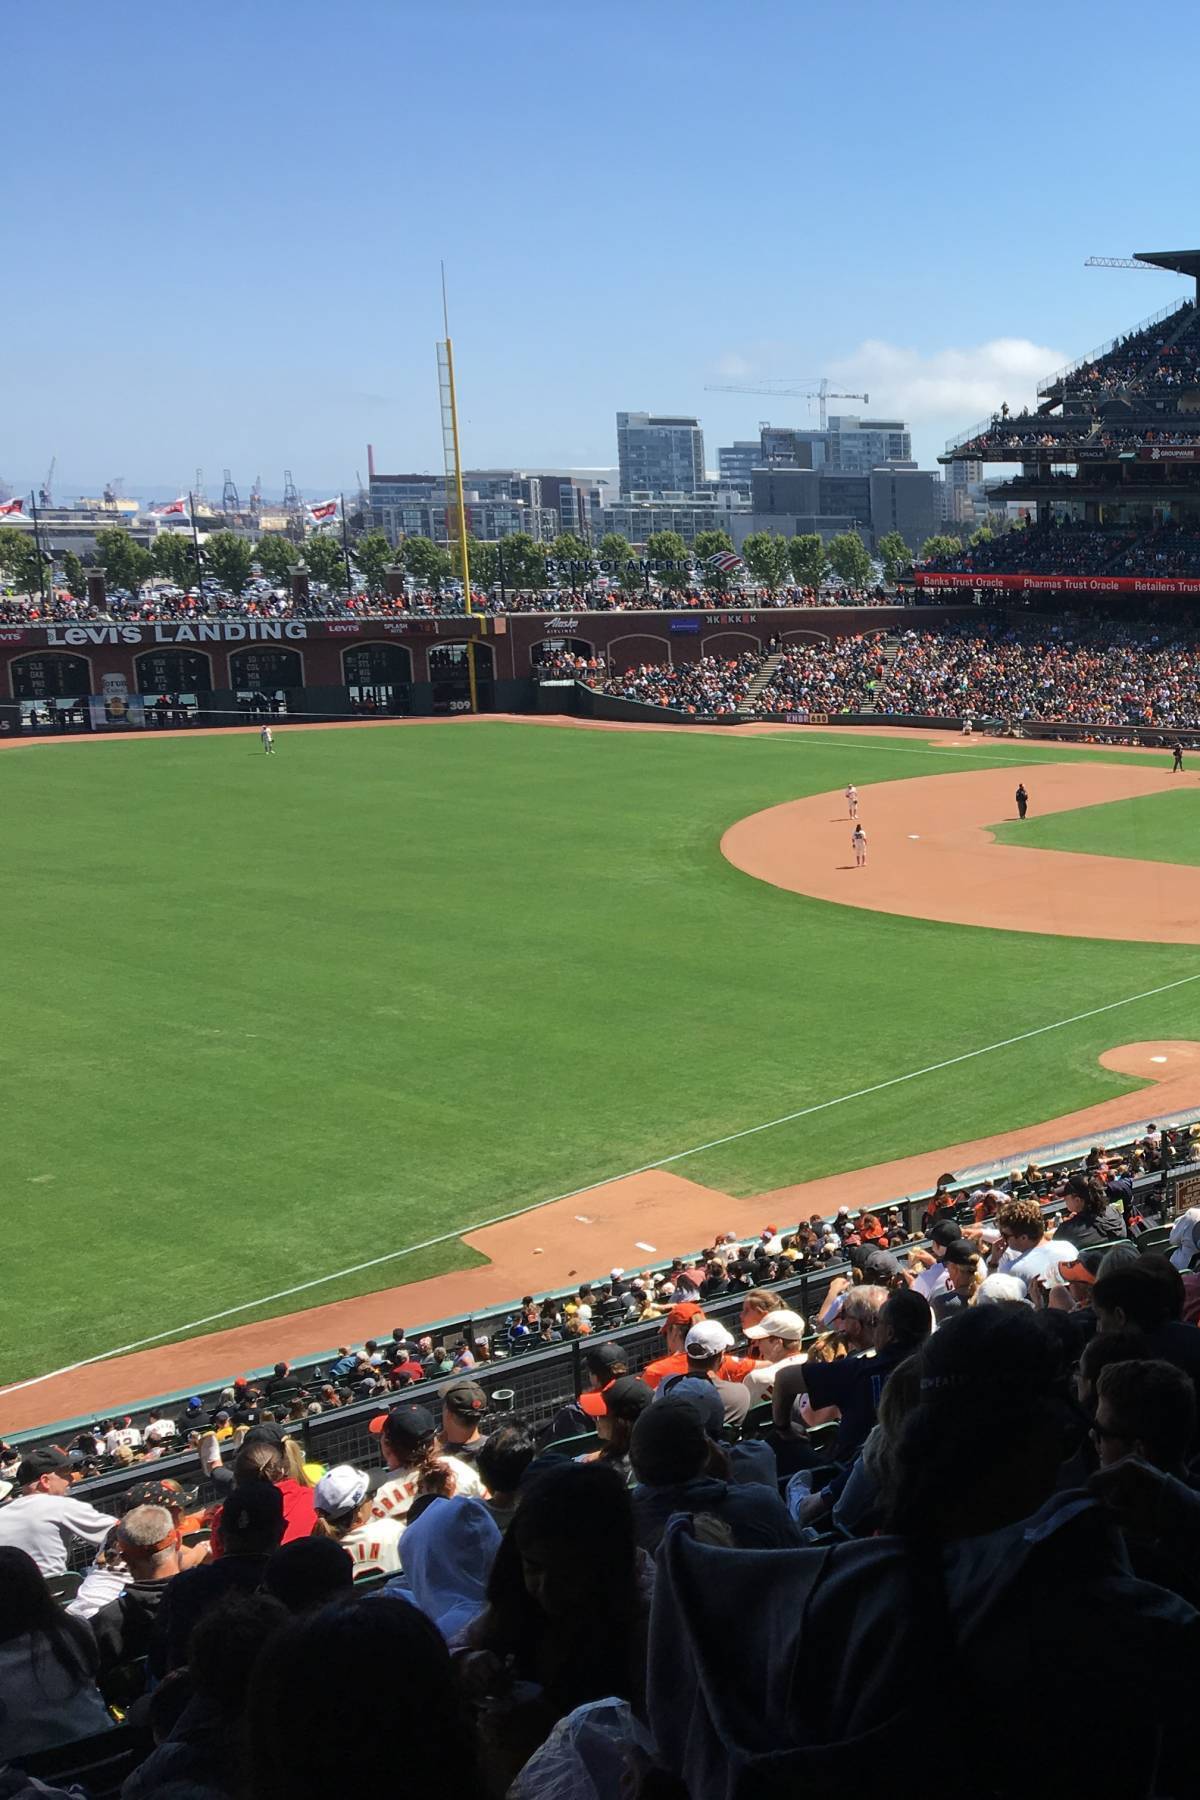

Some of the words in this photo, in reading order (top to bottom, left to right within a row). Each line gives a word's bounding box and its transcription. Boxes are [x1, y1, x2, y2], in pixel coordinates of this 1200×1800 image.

[545, 560, 592, 572] BANK
[599, 560, 620, 572] OF
[626, 559, 704, 572] AMERICA
[923, 576, 950, 586] Banks
[952, 577, 973, 586] Trust
[976, 577, 1004, 587] Oracle
[1023, 578, 1062, 589] Pharmas
[1064, 579, 1087, 589] Trust
[1090, 579, 1119, 590] Oracle
[1135, 581, 1175, 592] Retailers
[543, 617, 579, 628] Alaska
[46, 625, 143, 646] Levi's
[154, 621, 308, 643] LANDING
[449, 700, 471, 710] 309
[785, 714, 809, 723] KNBR
